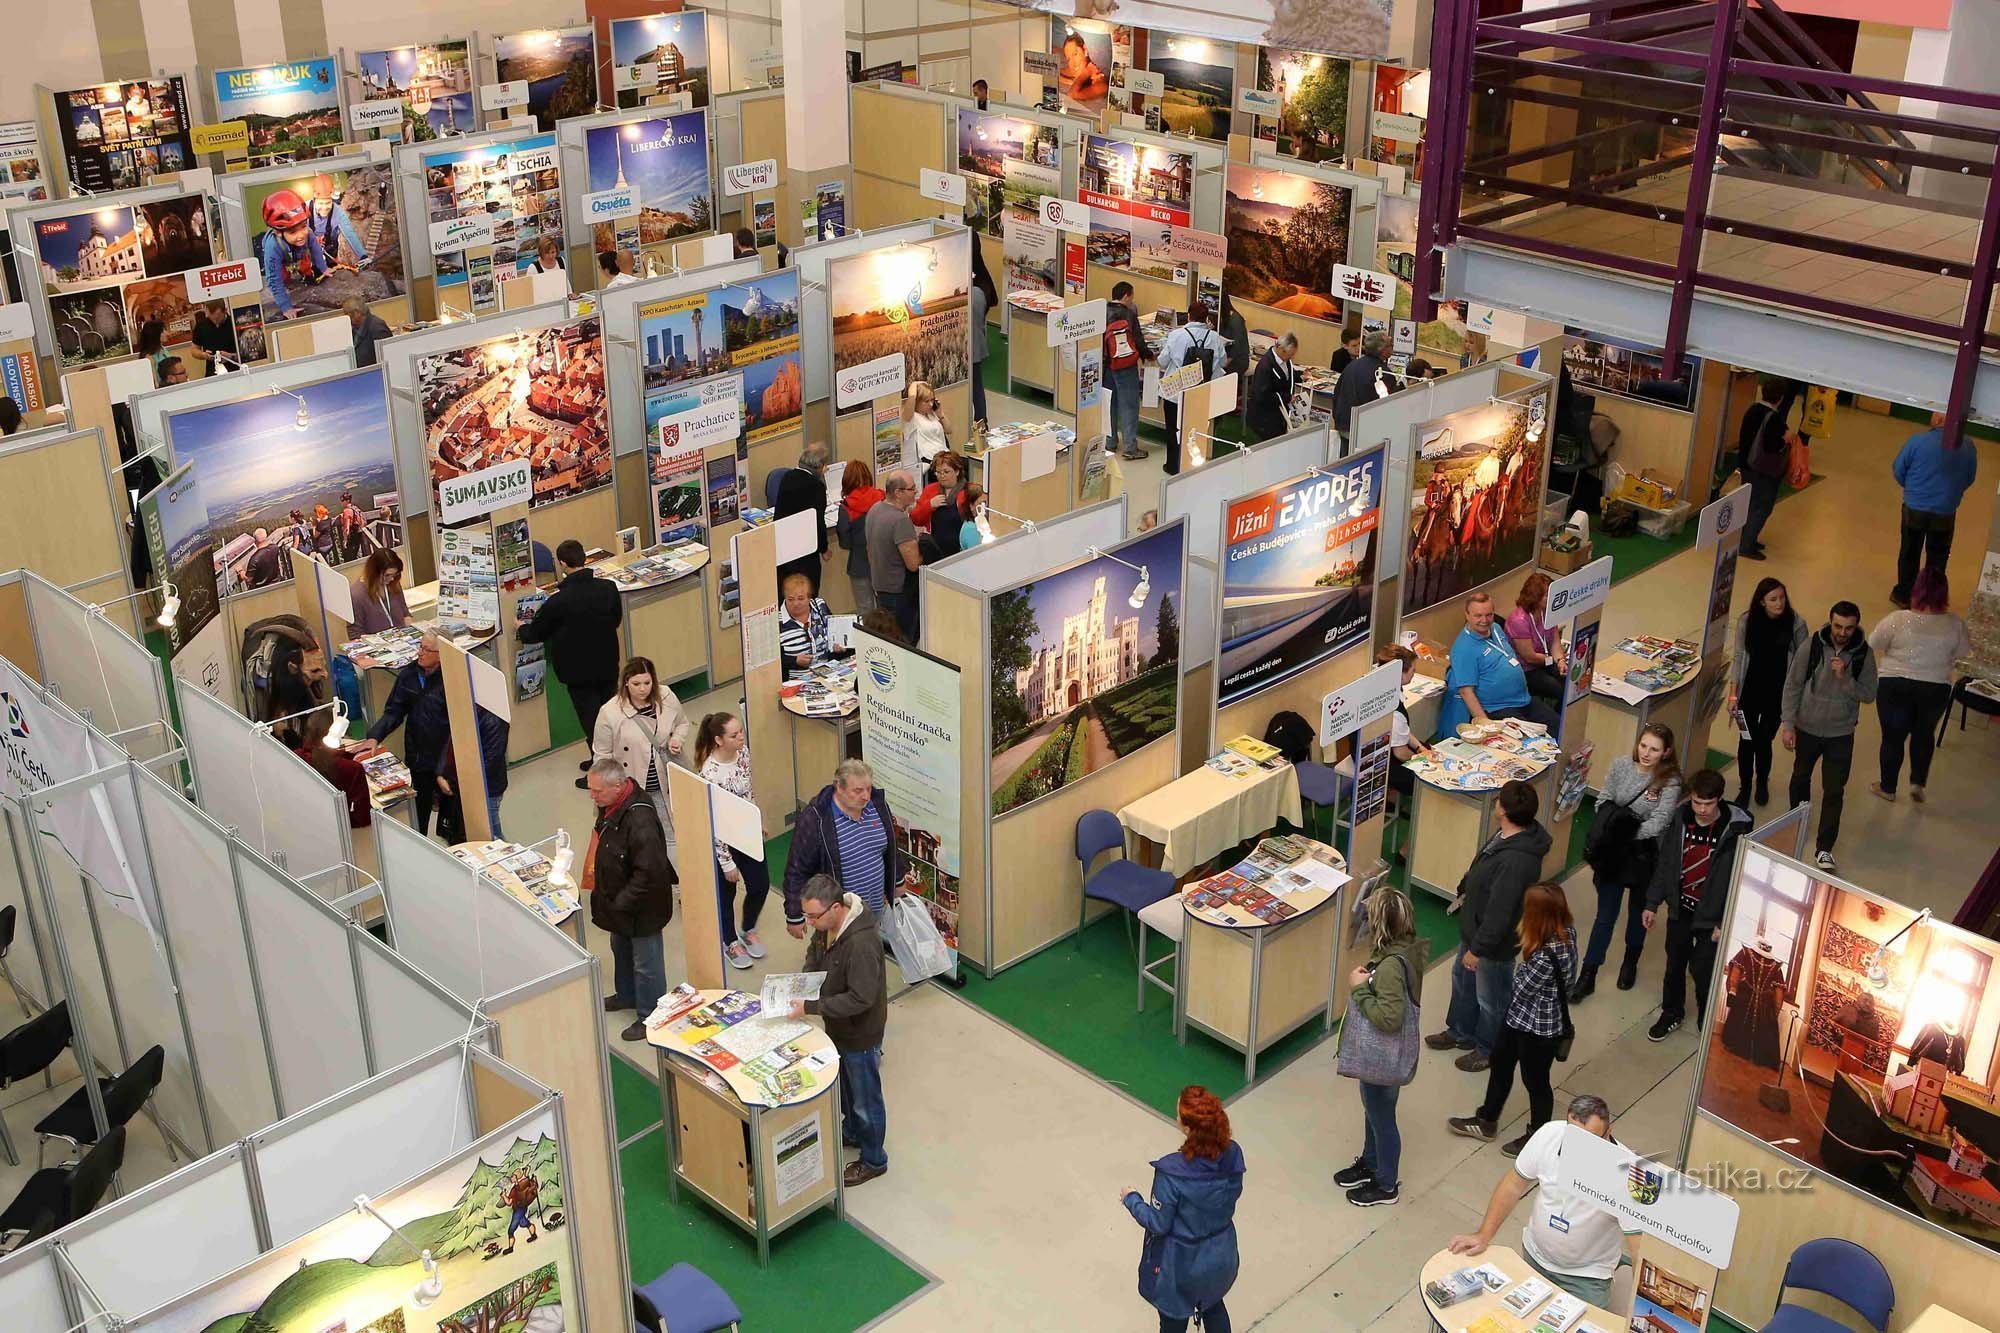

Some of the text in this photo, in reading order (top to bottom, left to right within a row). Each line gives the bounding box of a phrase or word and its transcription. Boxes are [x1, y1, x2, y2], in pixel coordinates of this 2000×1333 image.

[228, 65, 312, 88] NEPMUK
[175, 81, 188, 130] www.nomad.cz
[360, 106, 400, 119] Nepomuk
[100, 137, 162, 154] SVĚT PATŘÍ VÁM
[678, 134, 697, 145] KRAJ
[517, 156, 552, 172] ISCHIA
[752, 175, 767, 184] kraj
[592, 196, 632, 212] Osvěta
[1049, 206, 1062, 219] RS
[1087, 195, 1171, 221] BULHARSKO ŘECKO
[47, 223, 66, 234] Třebíč
[434, 227, 490, 251] Koruna Vysočiny
[1197, 246, 1224, 259] KANADA
[210, 268, 243, 284] Třebíč
[640, 308, 654, 317] EXPO
[926, 321, 959, 337] Pošumaví
[1069, 327, 1096, 338] Pošumaví
[6, 357, 24, 411] SLOVINSKO
[20, 354, 38, 408] MAĎARSKO
[858, 373, 900, 391] QUICKTOUR
[684, 411, 735, 433] Prachatice
[445, 470, 527, 507] ŠUMAVSKO
[477, 487, 527, 507] Turistická oblast
[1233, 461, 1373, 540] Jižní EXPRES
[1231, 545, 1258, 562] České
[1259, 527, 1309, 553] Budějovice
[1337, 509, 1348, 520] od
[1338, 530, 1344, 541] 1
[1351, 521, 1361, 534] 58
[1362, 515, 1375, 529] min
[1569, 583, 1588, 600] České
[1589, 575, 1608, 592] dráhy
[1337, 622, 1352, 634] České
[1353, 615, 1367, 627] dráhy
[1224, 657, 1282, 686] Lepší cesta každý den
[866, 693, 916, 726] Regionální
[918, 720, 951, 742] značka
[1331, 711, 1350, 724] NÁRODNÍ
[1572, 1178, 1712, 1256] Hornické muzeum Rudolfov
